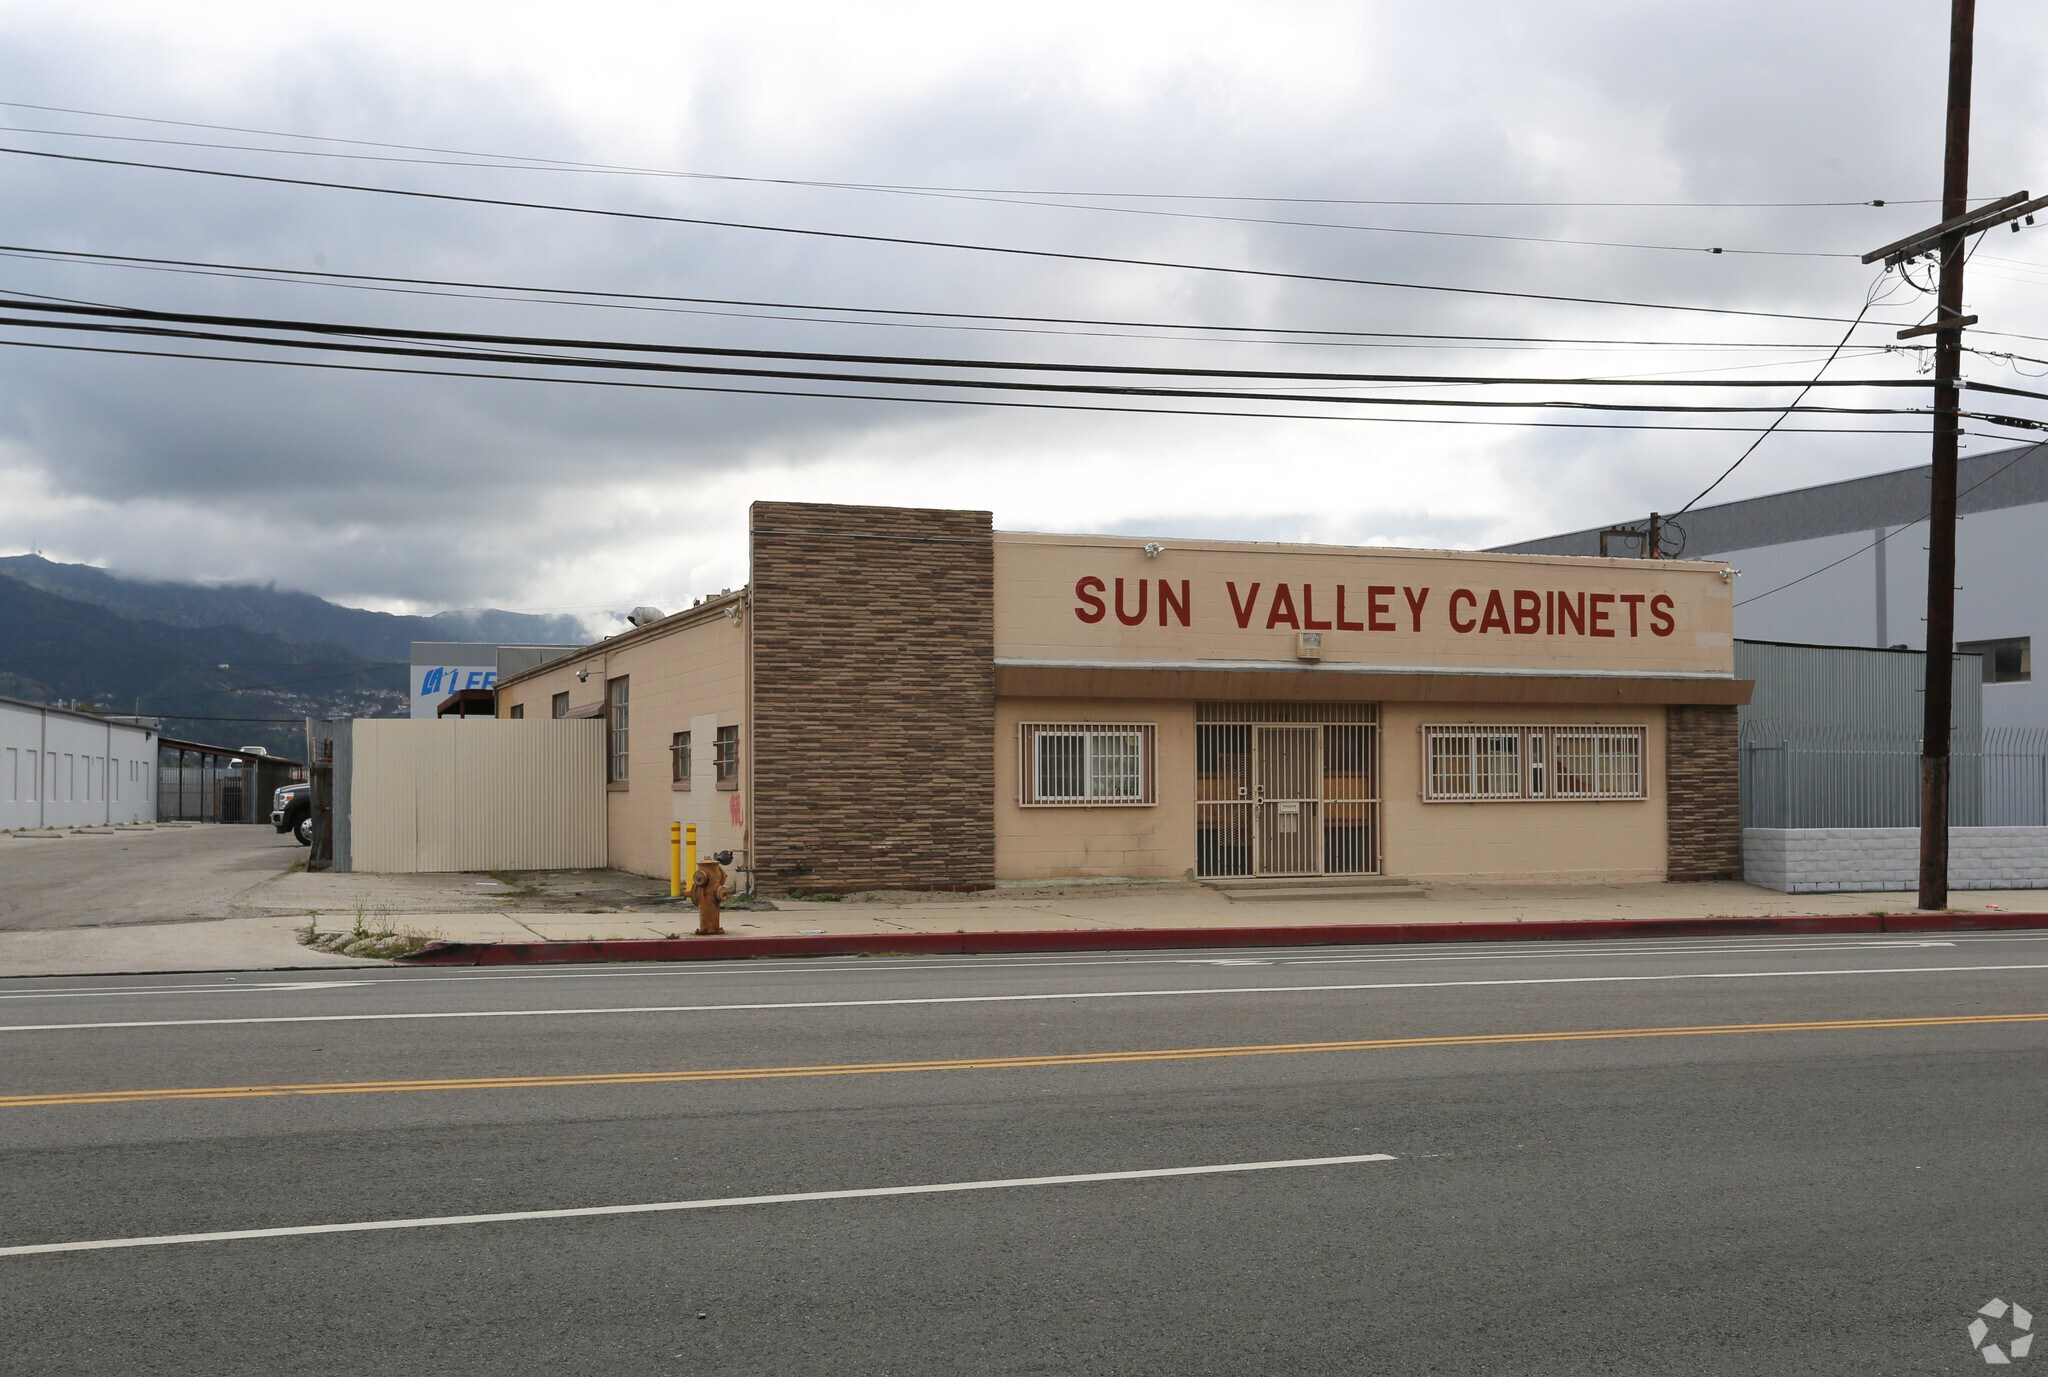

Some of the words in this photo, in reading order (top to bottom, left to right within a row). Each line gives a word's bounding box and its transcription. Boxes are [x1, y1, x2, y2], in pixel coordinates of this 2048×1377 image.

[1075, 576, 1191, 626] SUN
[1226, 581, 1429, 631] VALLEY
[1449, 589, 1674, 637] CABINETS
